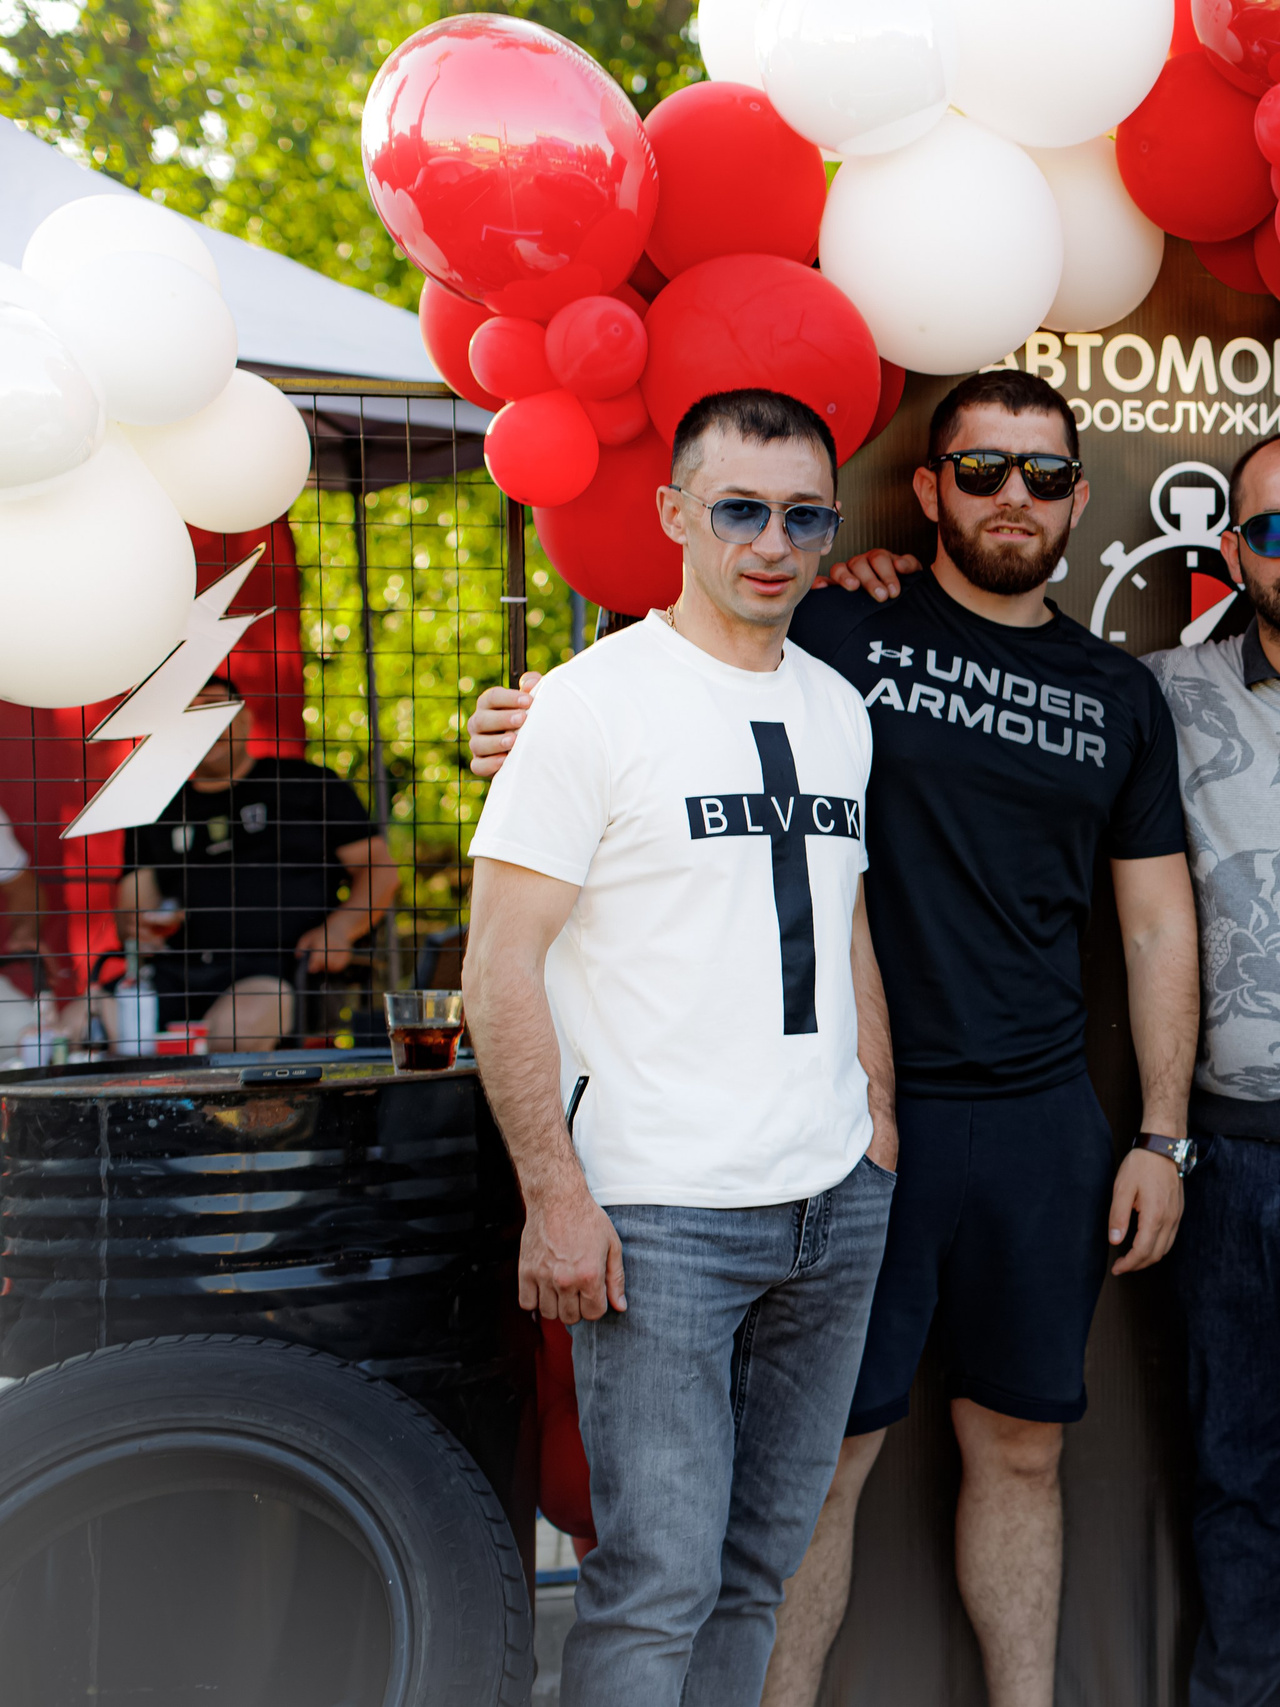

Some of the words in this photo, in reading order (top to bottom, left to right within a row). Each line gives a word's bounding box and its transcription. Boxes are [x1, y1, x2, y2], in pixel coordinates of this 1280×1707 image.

[863, 677, 1106, 768] ARMOUR
[926, 649, 1105, 728] UNDER
[700, 796, 860, 838] BLVCK
